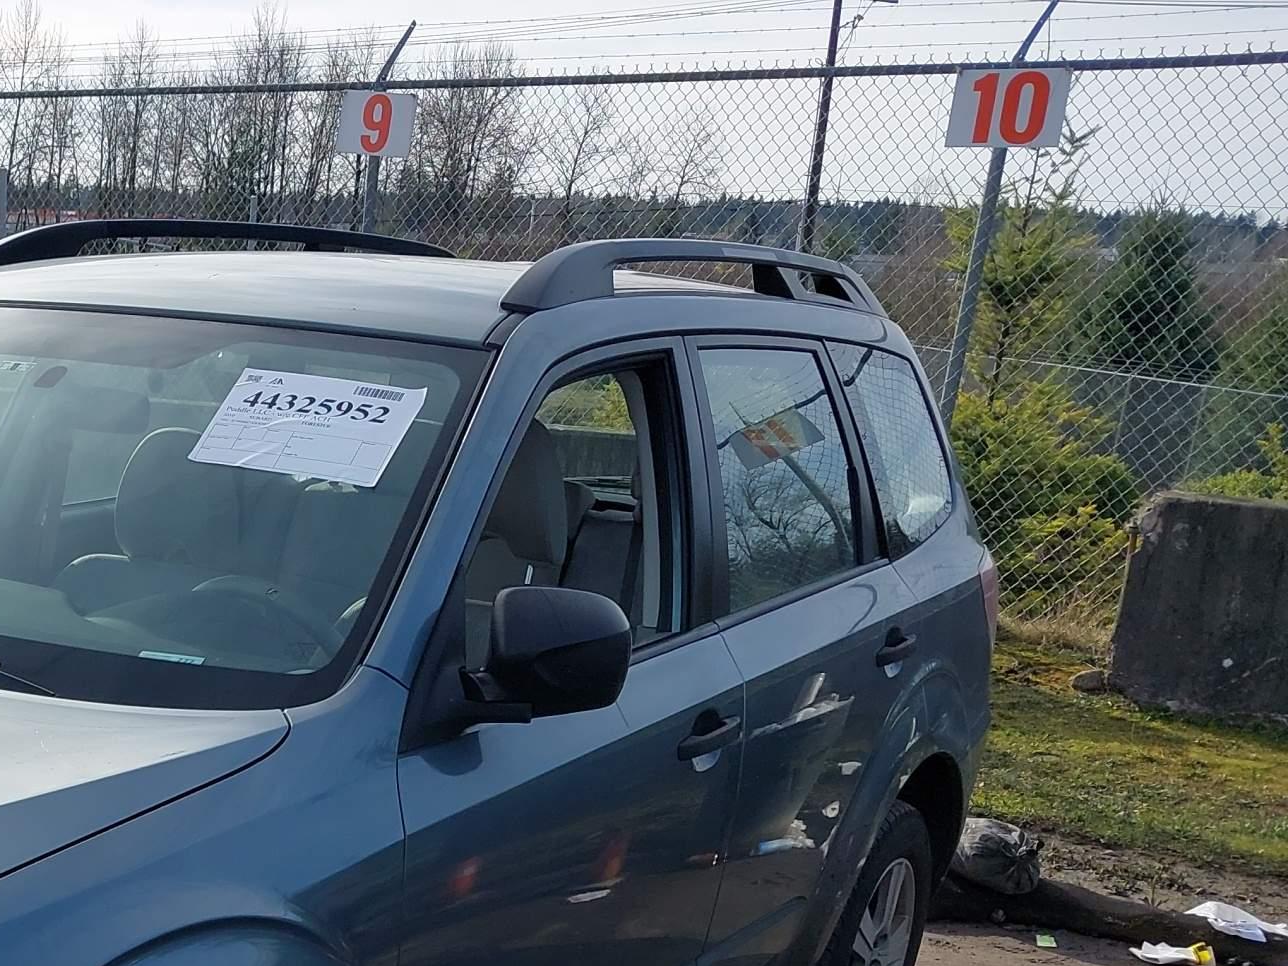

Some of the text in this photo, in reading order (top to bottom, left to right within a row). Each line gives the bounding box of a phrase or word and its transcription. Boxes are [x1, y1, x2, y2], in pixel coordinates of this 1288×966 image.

[361, 95, 392, 152] 9
[973, 71, 1050, 145] 10
[242, 390, 390, 424] 44325952
